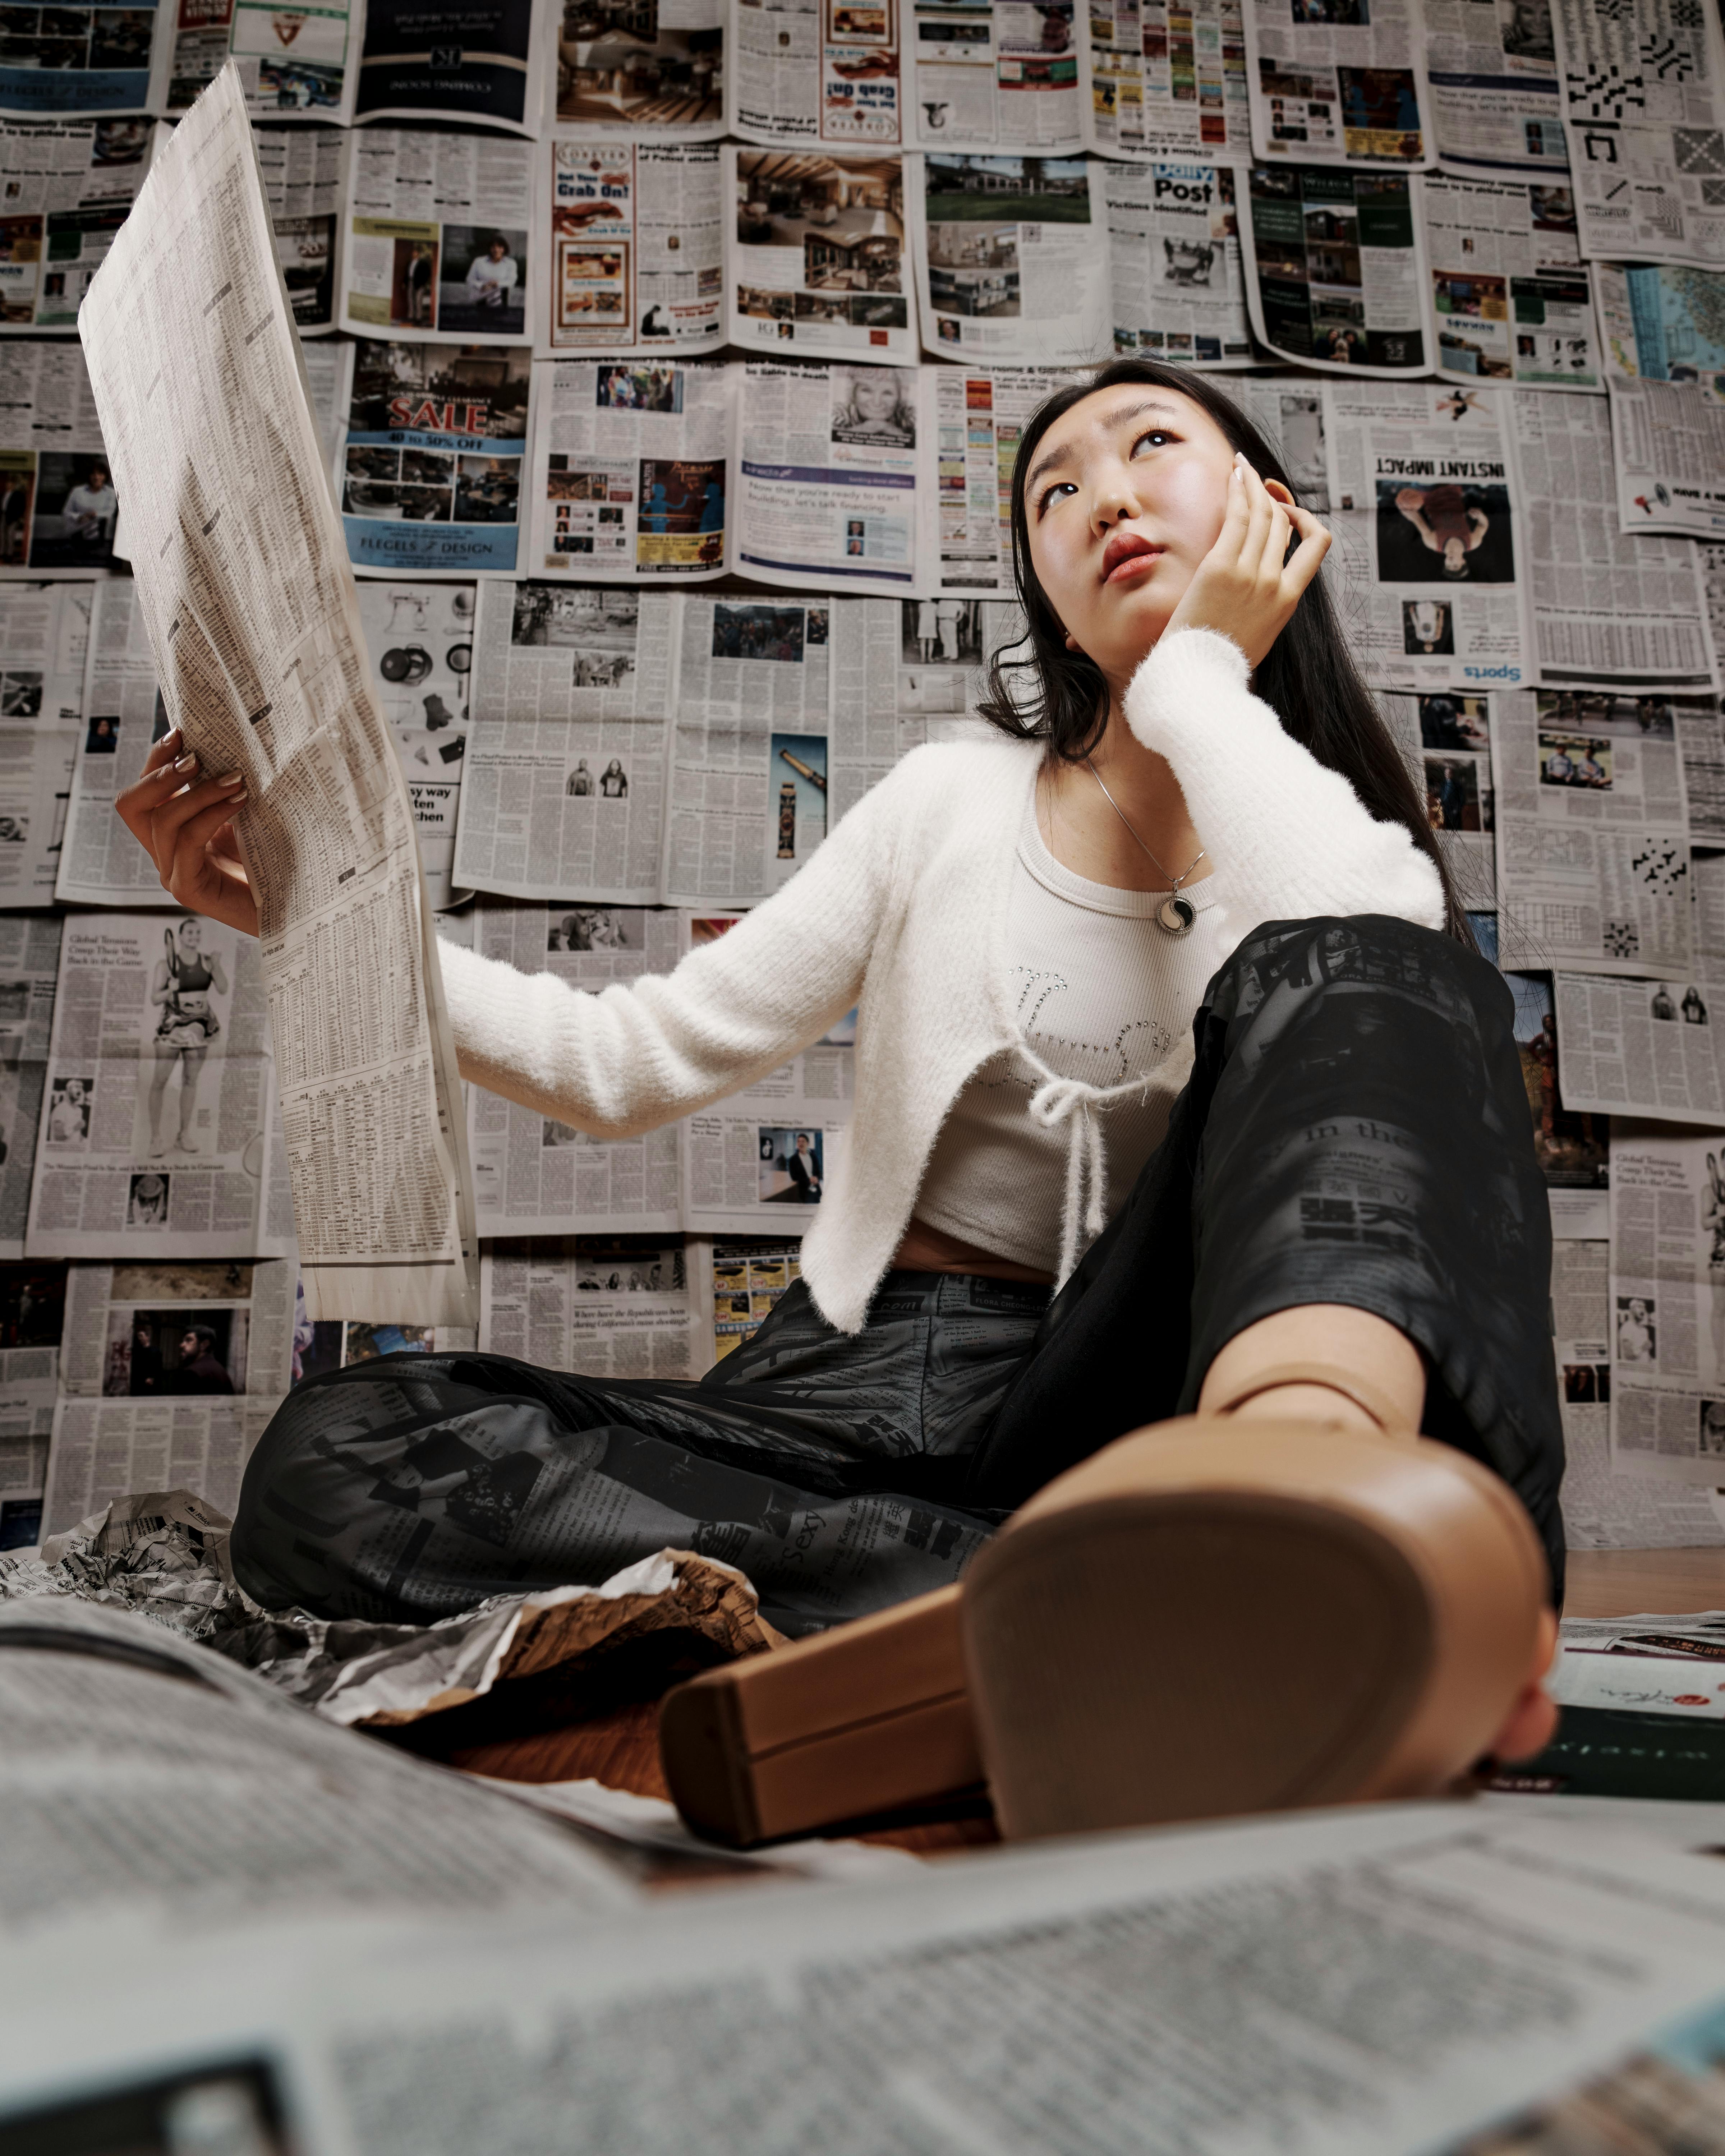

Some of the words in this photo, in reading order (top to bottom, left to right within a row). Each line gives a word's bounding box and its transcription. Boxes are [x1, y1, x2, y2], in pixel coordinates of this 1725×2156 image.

[434, 79, 492, 93] COMING
[827, 83, 854, 97] On!
[1155, 164, 1213, 181] Daily
[601, 184, 629, 198] On!
[1155, 179, 1213, 204] Post
[1105, 200, 1149, 210] Victims
[1153, 202, 1208, 216] identified
[388, 397, 487, 434] SALE
[388, 432, 404, 443] 40
[425, 434, 454, 447] 50%
[456, 438, 483, 450] OFF
[1376, 458, 1435, 476] IMPACT
[1439, 461, 1505, 478] INSTANT
[748, 481, 772, 492] Now
[775, 485, 796, 496] that
[798, 488, 830, 499] you're
[831, 490, 860, 502] ready
[863, 492, 874, 501] to
[877, 493, 900, 502] start
[1673, 487, 1701, 500] HAVE
[1704, 490, 1711, 500] A
[795, 498, 815, 508] let's
[819, 498, 836, 508] talk
[840, 500, 887, 515] financing.
[360, 536, 417, 553] FLEGELS
[441, 541, 493, 554] DESIGN
[1464, 665, 1521, 682] Sports
[427, 788, 451, 800] way
[69, 934, 98, 944] Global
[101, 935, 138, 944] Tensions
[97, 946, 119, 955] Their
[121, 946, 141, 957] Way
[67, 955, 88, 966] Back
[100, 957, 114, 966] the
[116, 957, 143, 967] Game
[1306, 1123, 1338, 1142] in
[1356, 1122, 1407, 1148] the
[975, 1298, 999, 1306] FLORA
[626, 1308, 668, 1318] Republicans
[597, 1319, 635, 1328] California's
[195, 1512, 210, 1526] Friday,
[781, 1509, 827, 1566] Sexy
[823, 1548, 845, 1577] Hong
[837, 1516, 856, 1545] Kong
[2, 1560, 12, 1572] 2000
